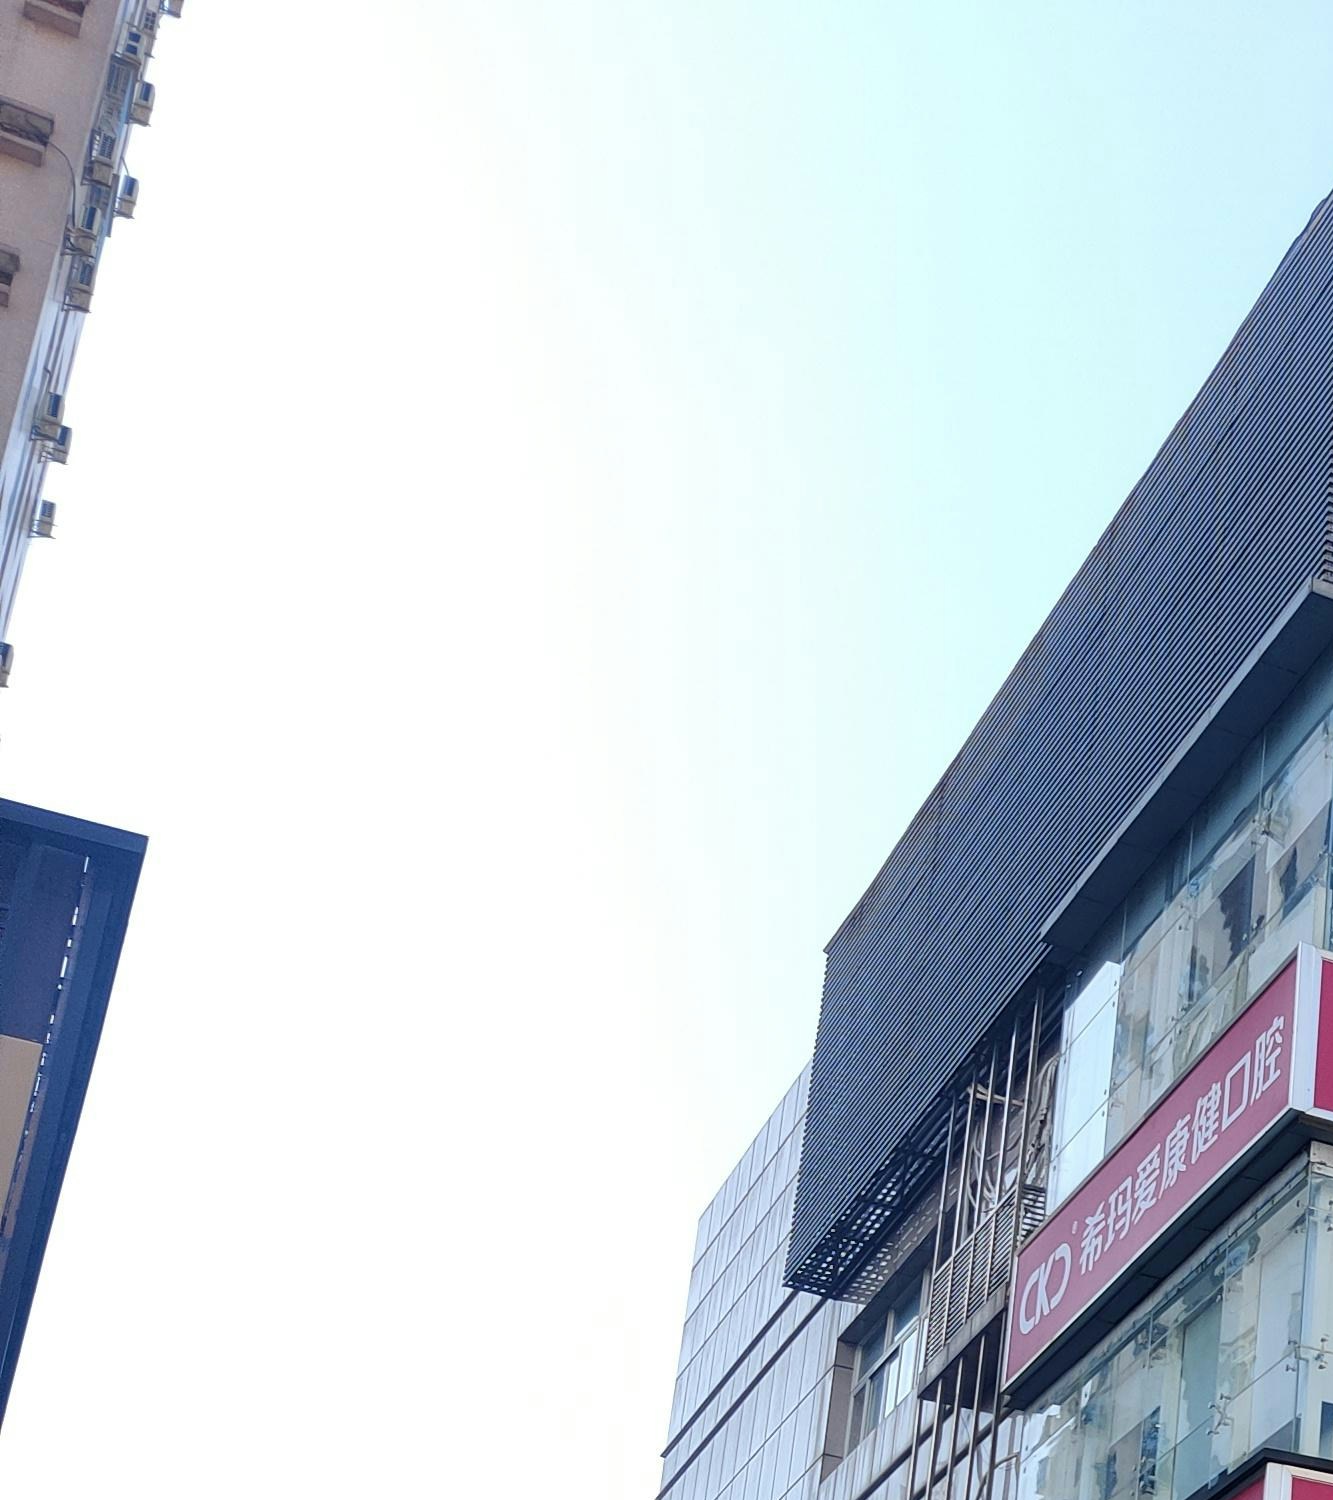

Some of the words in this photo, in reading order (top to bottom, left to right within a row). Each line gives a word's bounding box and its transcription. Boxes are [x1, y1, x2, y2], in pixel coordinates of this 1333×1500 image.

[1077, 1014, 1285, 1276] 希玛爱康健口腔
